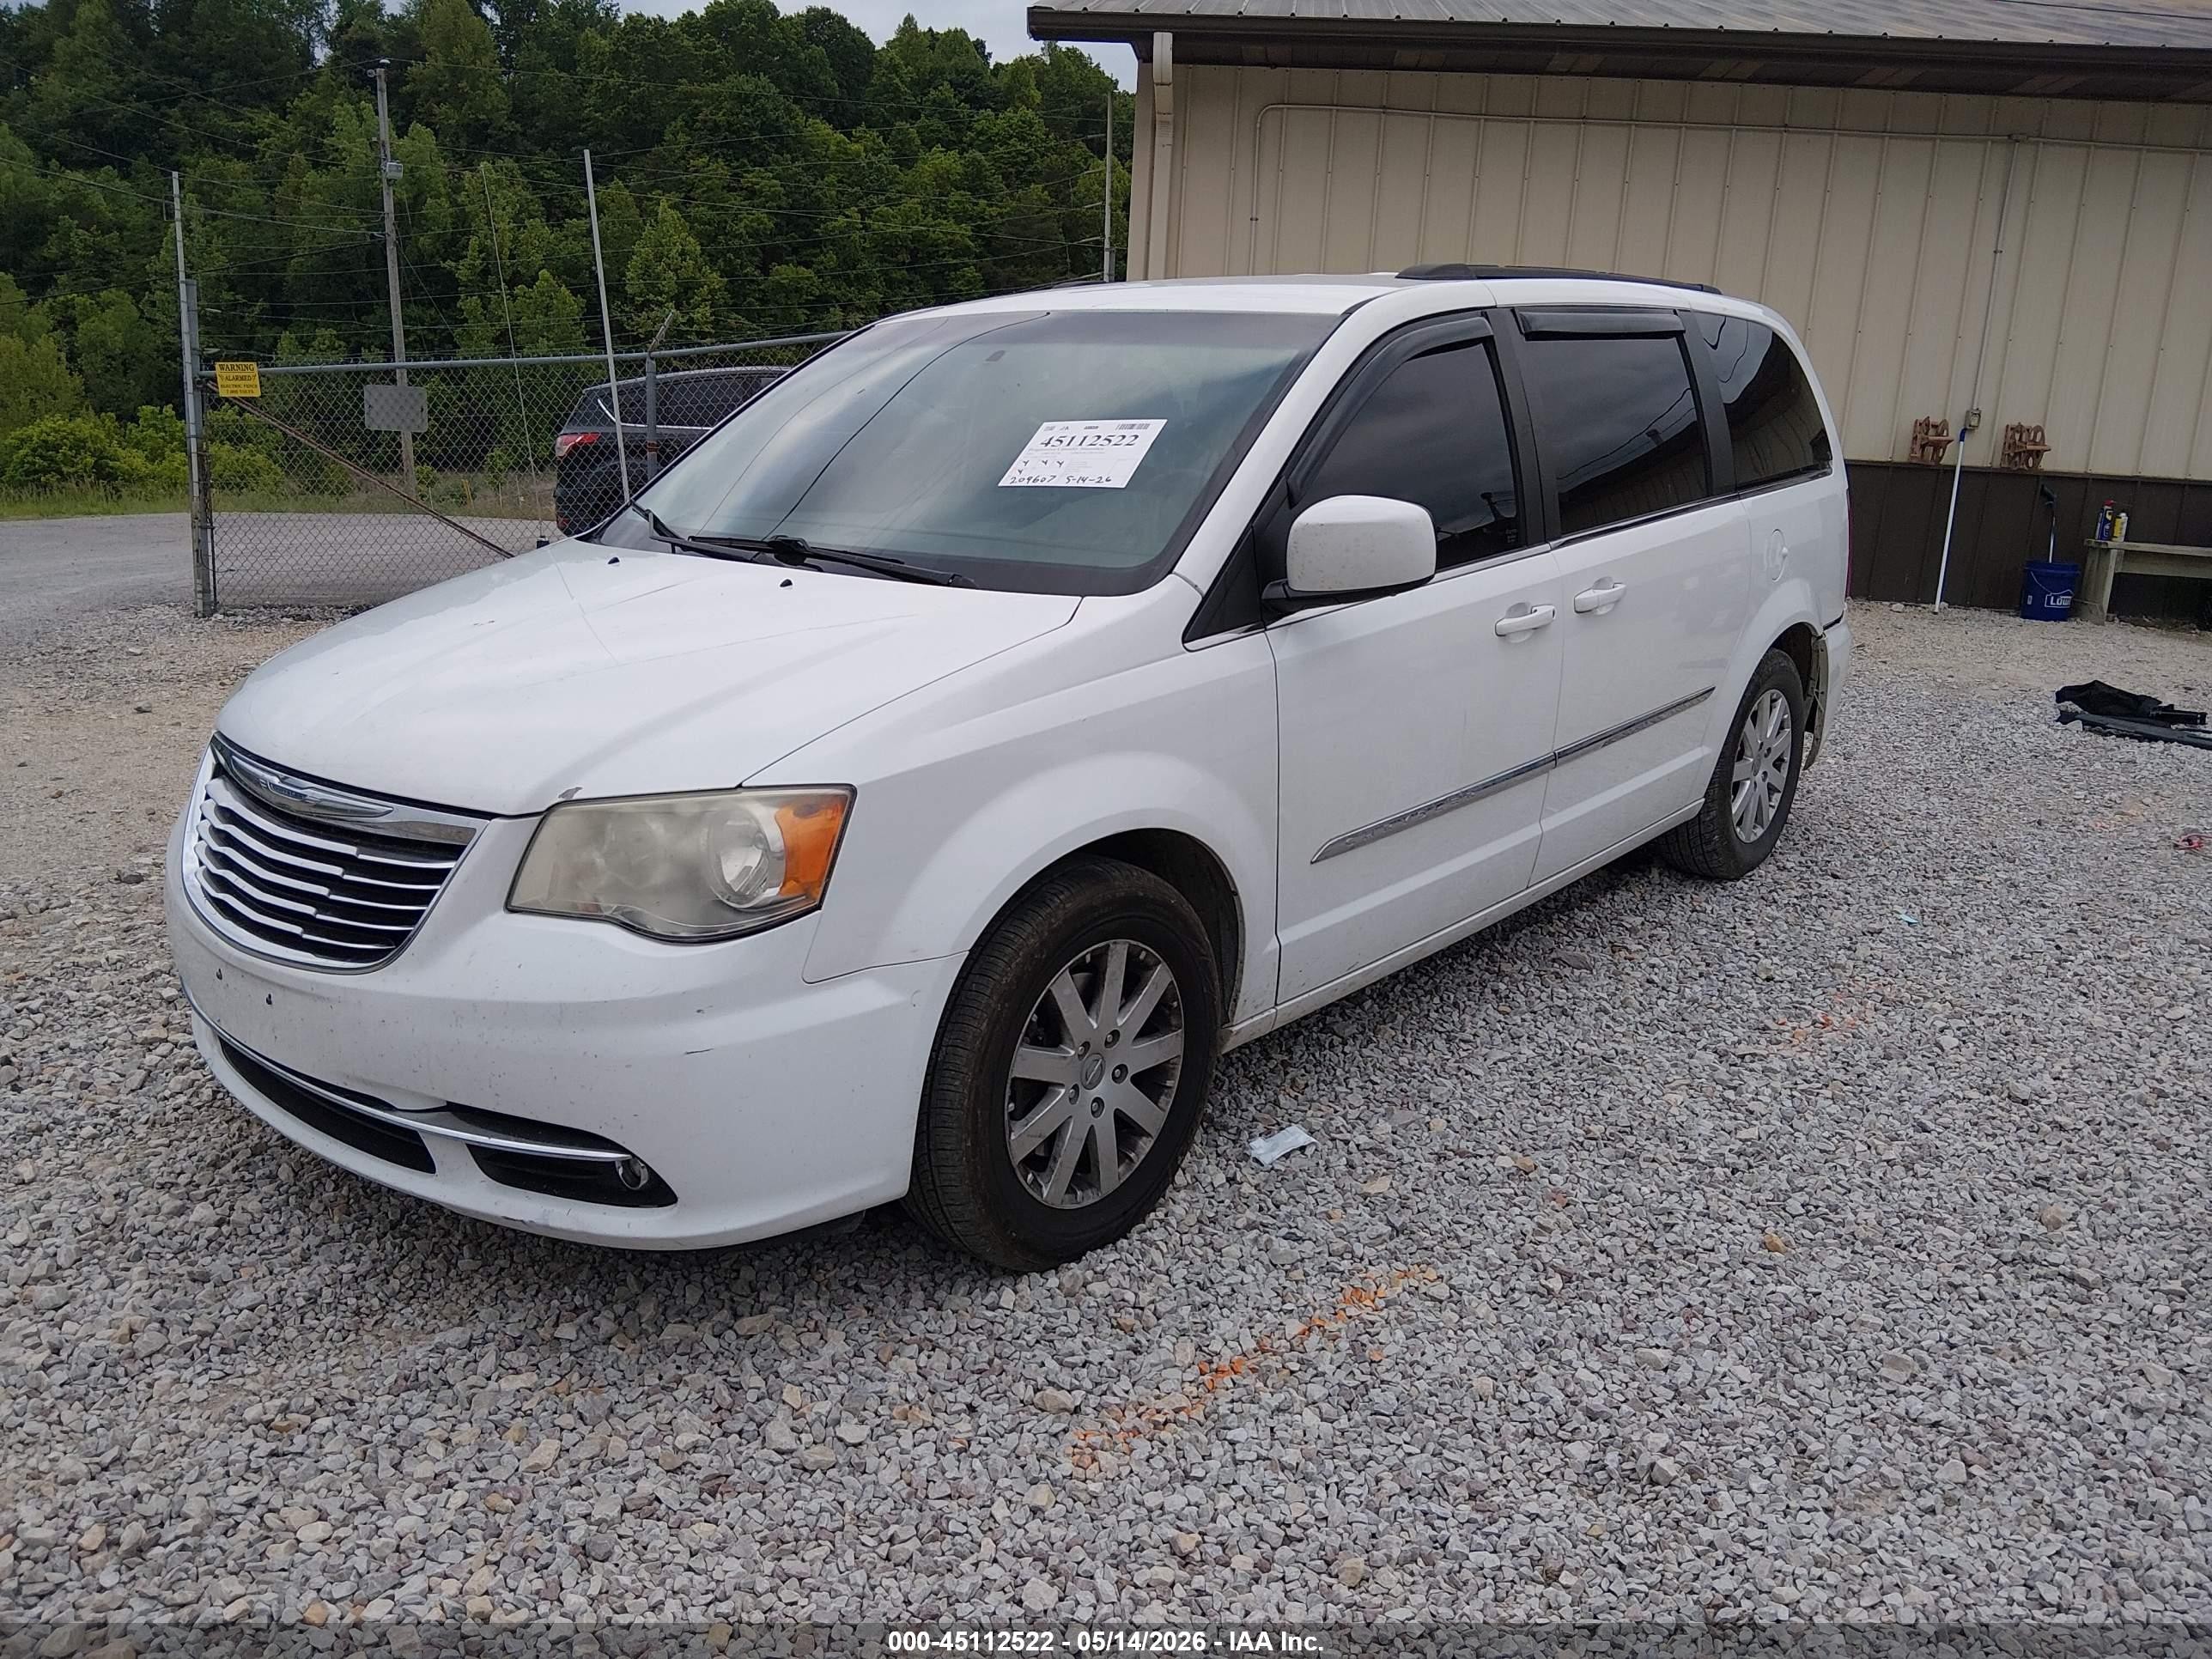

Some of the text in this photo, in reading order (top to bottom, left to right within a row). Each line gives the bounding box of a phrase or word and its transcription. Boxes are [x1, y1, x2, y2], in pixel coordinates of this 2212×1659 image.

[1040, 434, 1139, 447] 45112522
[1009, 474, 1113, 485] 209607 5-14-26
